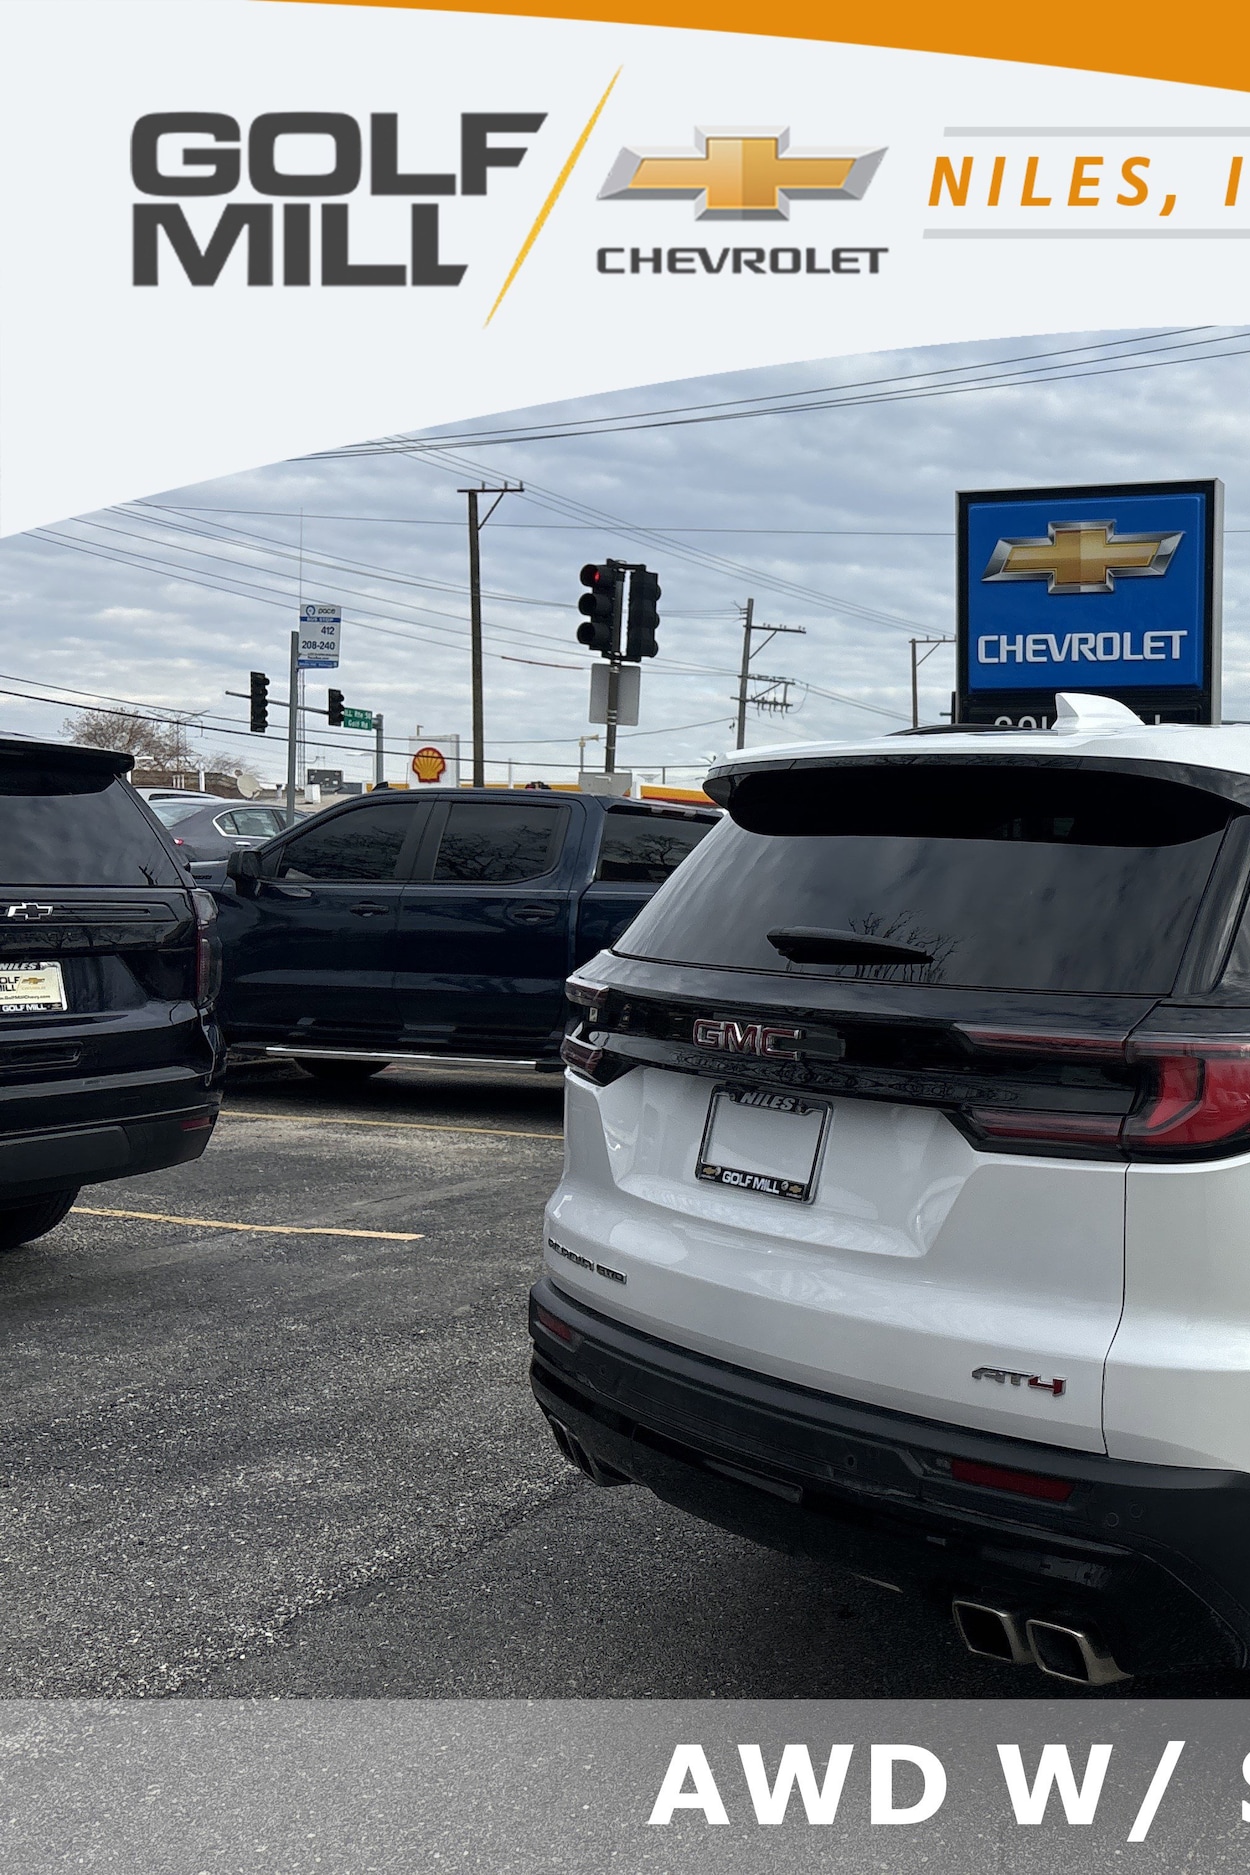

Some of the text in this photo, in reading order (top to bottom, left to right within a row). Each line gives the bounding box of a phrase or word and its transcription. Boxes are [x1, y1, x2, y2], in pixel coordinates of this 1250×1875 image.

[320, 626, 335, 635] 412
[302, 641, 336, 651] 208-240
[978, 630, 1187, 663] CHEVROLET
[693, 1019, 801, 1061] GMC
[740, 1092, 796, 1110] NILES
[722, 1170, 780, 1194] GOLF MILL
[971, 1365, 1068, 1397] AT4
